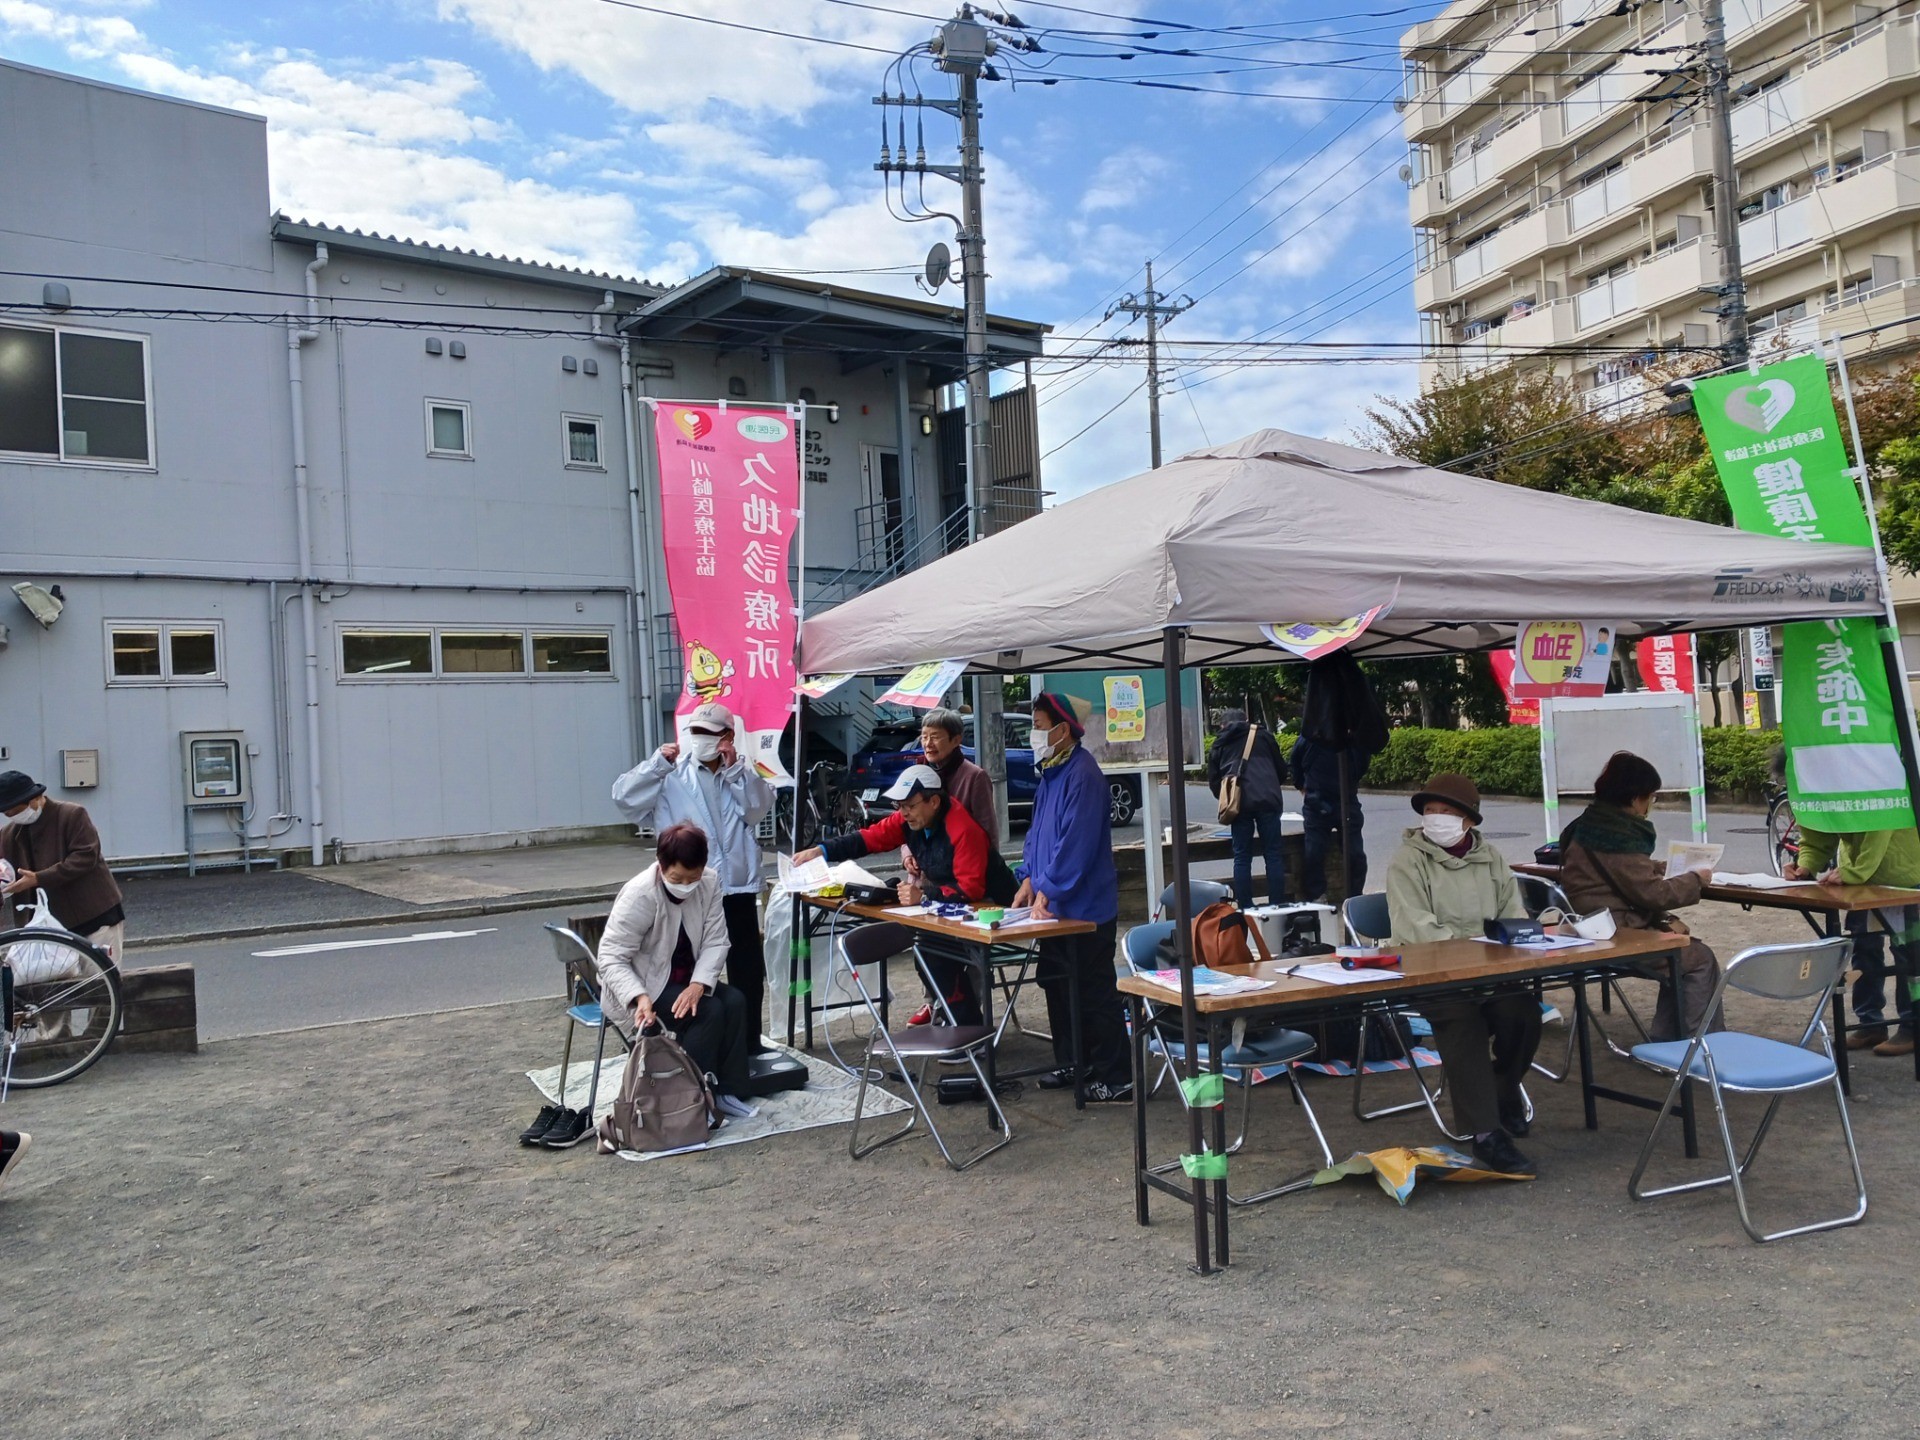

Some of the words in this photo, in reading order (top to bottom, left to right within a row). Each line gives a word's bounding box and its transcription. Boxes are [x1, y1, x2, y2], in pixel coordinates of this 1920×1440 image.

[1729, 582, 1785, 596] FIELDOOR
[1532, 633, 1576, 660] 血圧
[1562, 665, 1583, 679] 測定
